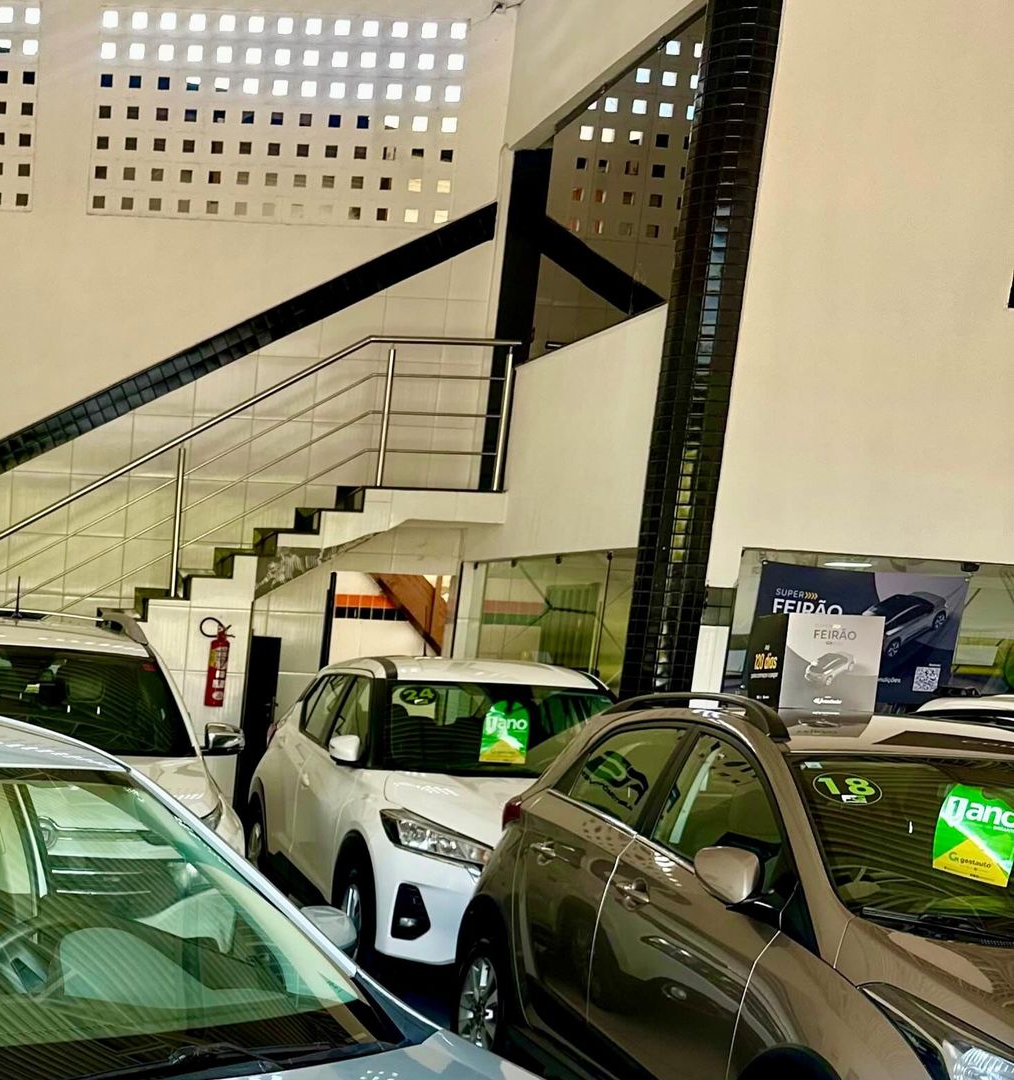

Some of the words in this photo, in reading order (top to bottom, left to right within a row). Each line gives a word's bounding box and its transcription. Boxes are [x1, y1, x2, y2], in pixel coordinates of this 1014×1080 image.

[775, 587, 805, 599] SUPER
[813, 628, 857, 641] FEIRÃO
[403, 688, 435, 701] 24
[497, 718, 528, 730] ano
[817, 777, 876, 796] 18
[960, 857, 992, 869] gestauto
